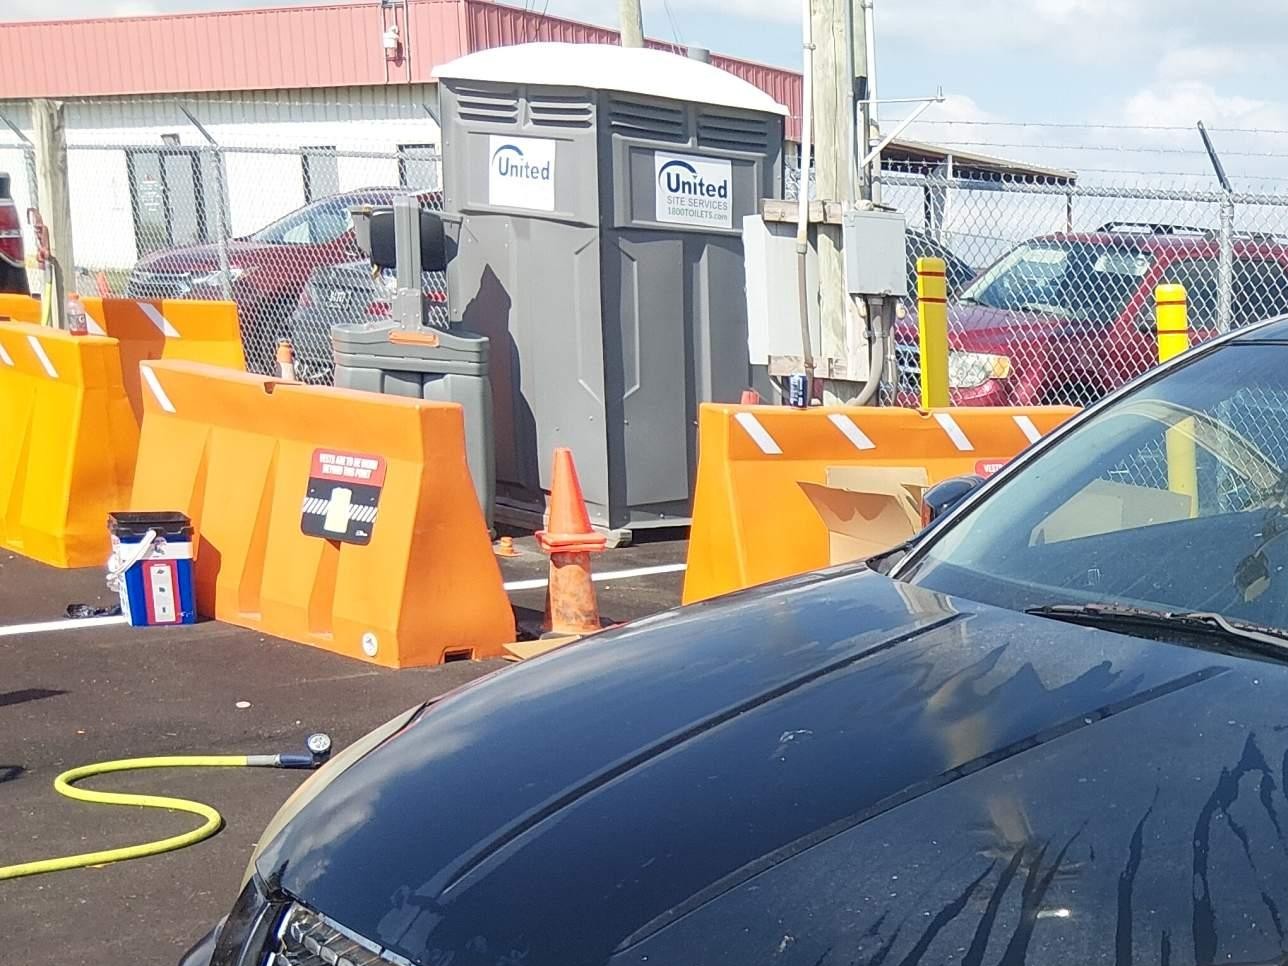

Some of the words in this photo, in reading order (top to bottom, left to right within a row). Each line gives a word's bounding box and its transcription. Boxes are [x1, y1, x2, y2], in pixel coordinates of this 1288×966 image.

[499, 156, 550, 181] United
[666, 172, 728, 199] United
[666, 195, 686, 206] SITE
[688, 198, 728, 210] SERVICES
[668, 207, 728, 220] 1800TOILETS.com
